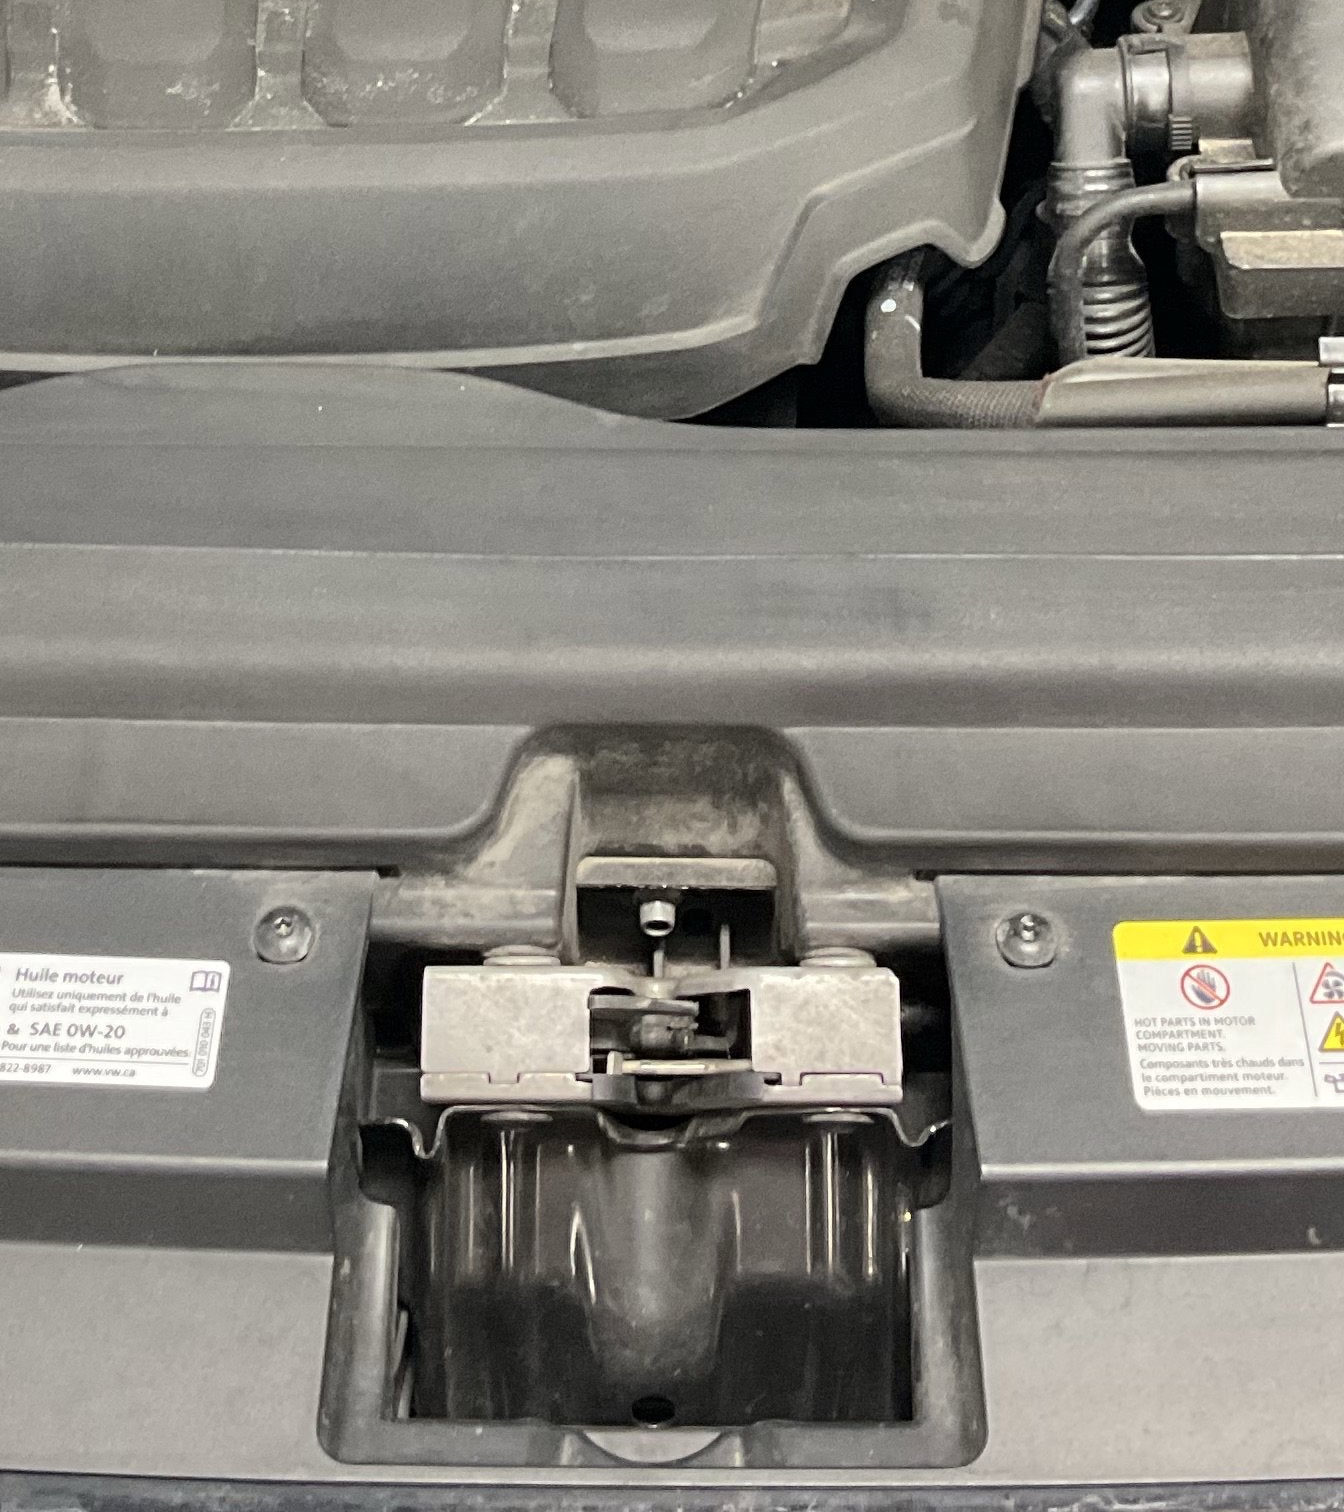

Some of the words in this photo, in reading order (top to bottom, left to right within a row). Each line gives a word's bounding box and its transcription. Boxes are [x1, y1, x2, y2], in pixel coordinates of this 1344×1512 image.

[15, 967, 58, 982] Huile
[62, 970, 124, 985] moteur
[12, 988, 54, 1000] Utilisez
[57, 990, 126, 1004] uniquement
[130, 991, 144, 1003] de
[147, 992, 182, 1004] l'huile
[9, 1001, 27, 1014] qui
[30, 1002, 75, 1014] satisfait
[78, 1004, 158, 1017] expressément
[161, 1006, 169, 1017] à
[1134, 1017, 1157, 1028] HOT
[1160, 1017, 1196, 1027] PARTS
[1199, 1016, 1210, 1027] IN
[1214, 1015, 1255, 1026] MOTOR
[7, 1023, 20, 1035] &
[30, 1022, 62, 1037] SAE
[66, 1023, 126, 1039] 0W-20
[1, 1040, 27, 1052] Pour
[30, 1043, 51, 1052] une
[54, 1042, 76, 1054] liste
[79, 1043, 121, 1056] d'huiles
[1137, 1042, 1184, 1053] MOVING
[1187, 1042, 1225, 1053] PARTS.
[72, 1065, 136, 1077] www.vw.ca
[1139, 1058, 1209, 1071] Composants
[1236, 1057, 1276, 1068] chauds
[1277, 1057, 1305, 1067] dans
[1141, 1072, 1152, 1083] le
[1155, 1072, 1239, 1085] compartiment
[1183, 1087, 1198, 1096] en
